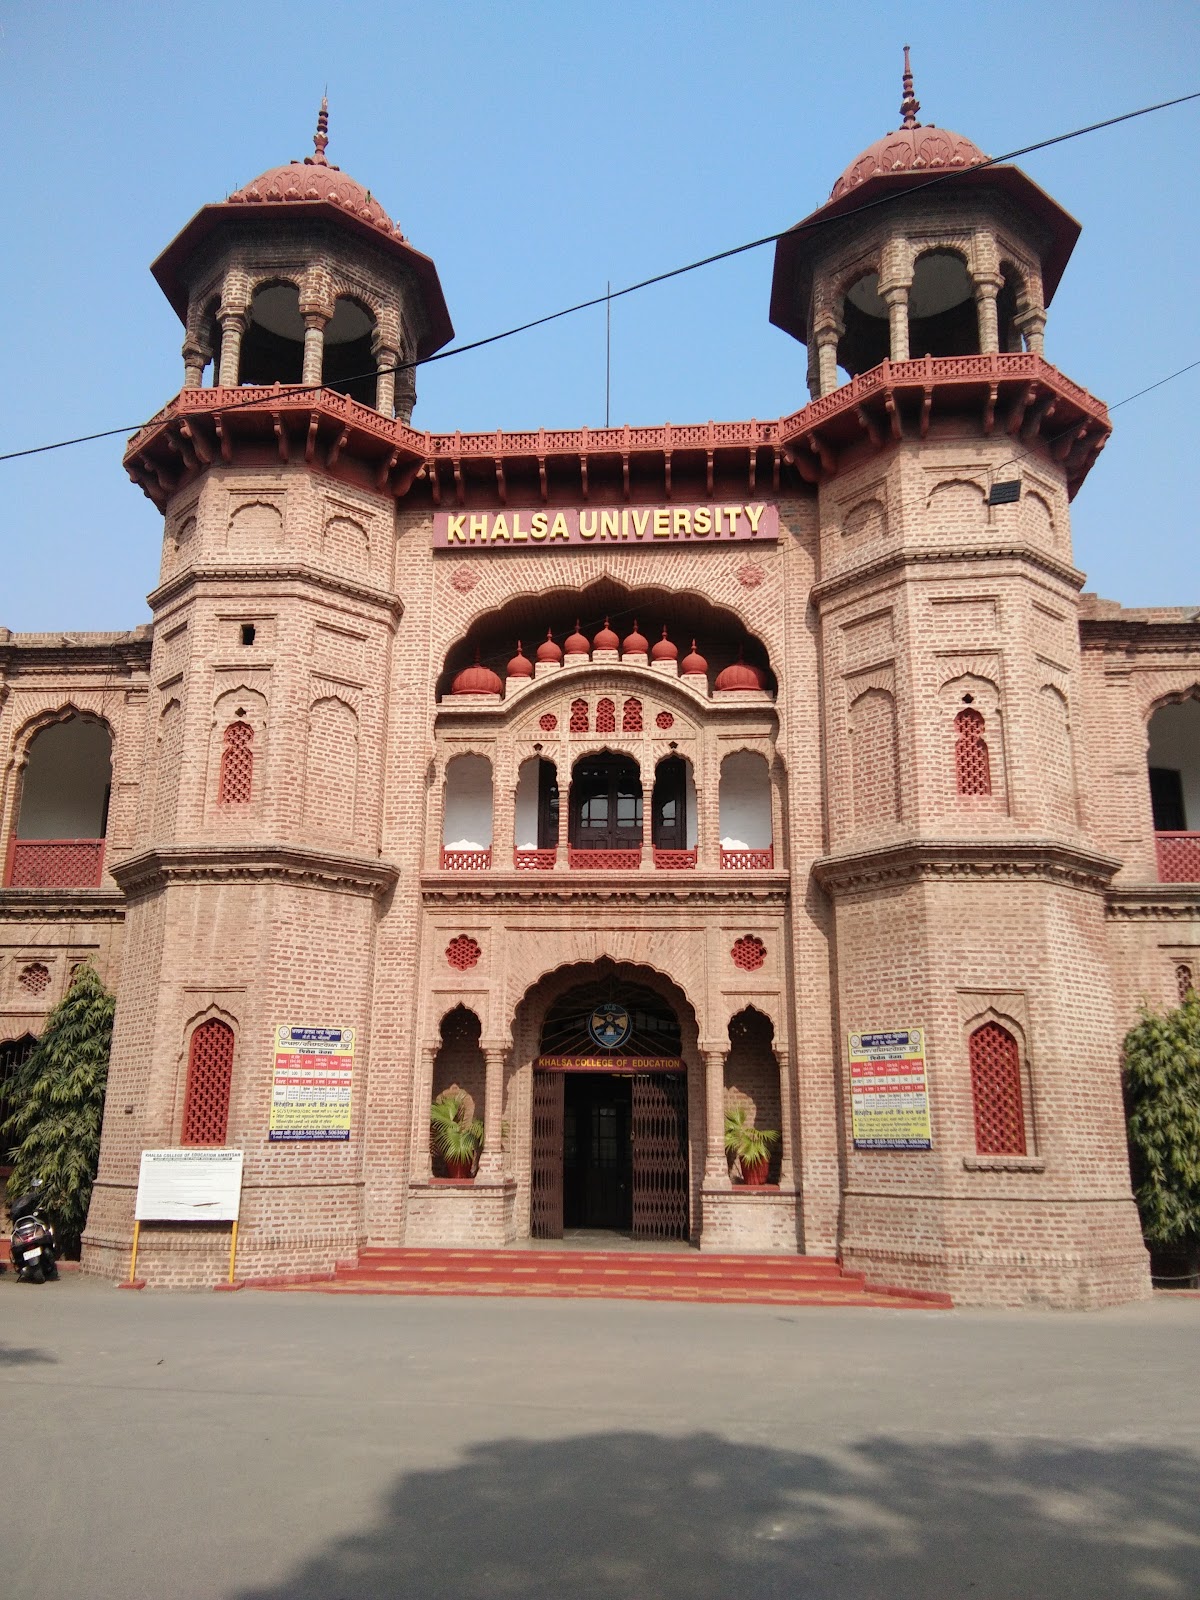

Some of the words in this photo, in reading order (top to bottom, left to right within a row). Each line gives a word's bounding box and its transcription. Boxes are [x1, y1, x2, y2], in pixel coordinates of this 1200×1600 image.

[447, 512, 570, 543] KHALSA
[579, 505, 765, 539] UNIVERSITY
[539, 1058, 572, 1067] KHALSA
[575, 1058, 613, 1067] COLLEGE
[616, 1058, 628, 1067] OF
[632, 1059, 680, 1068] EDUCATION
